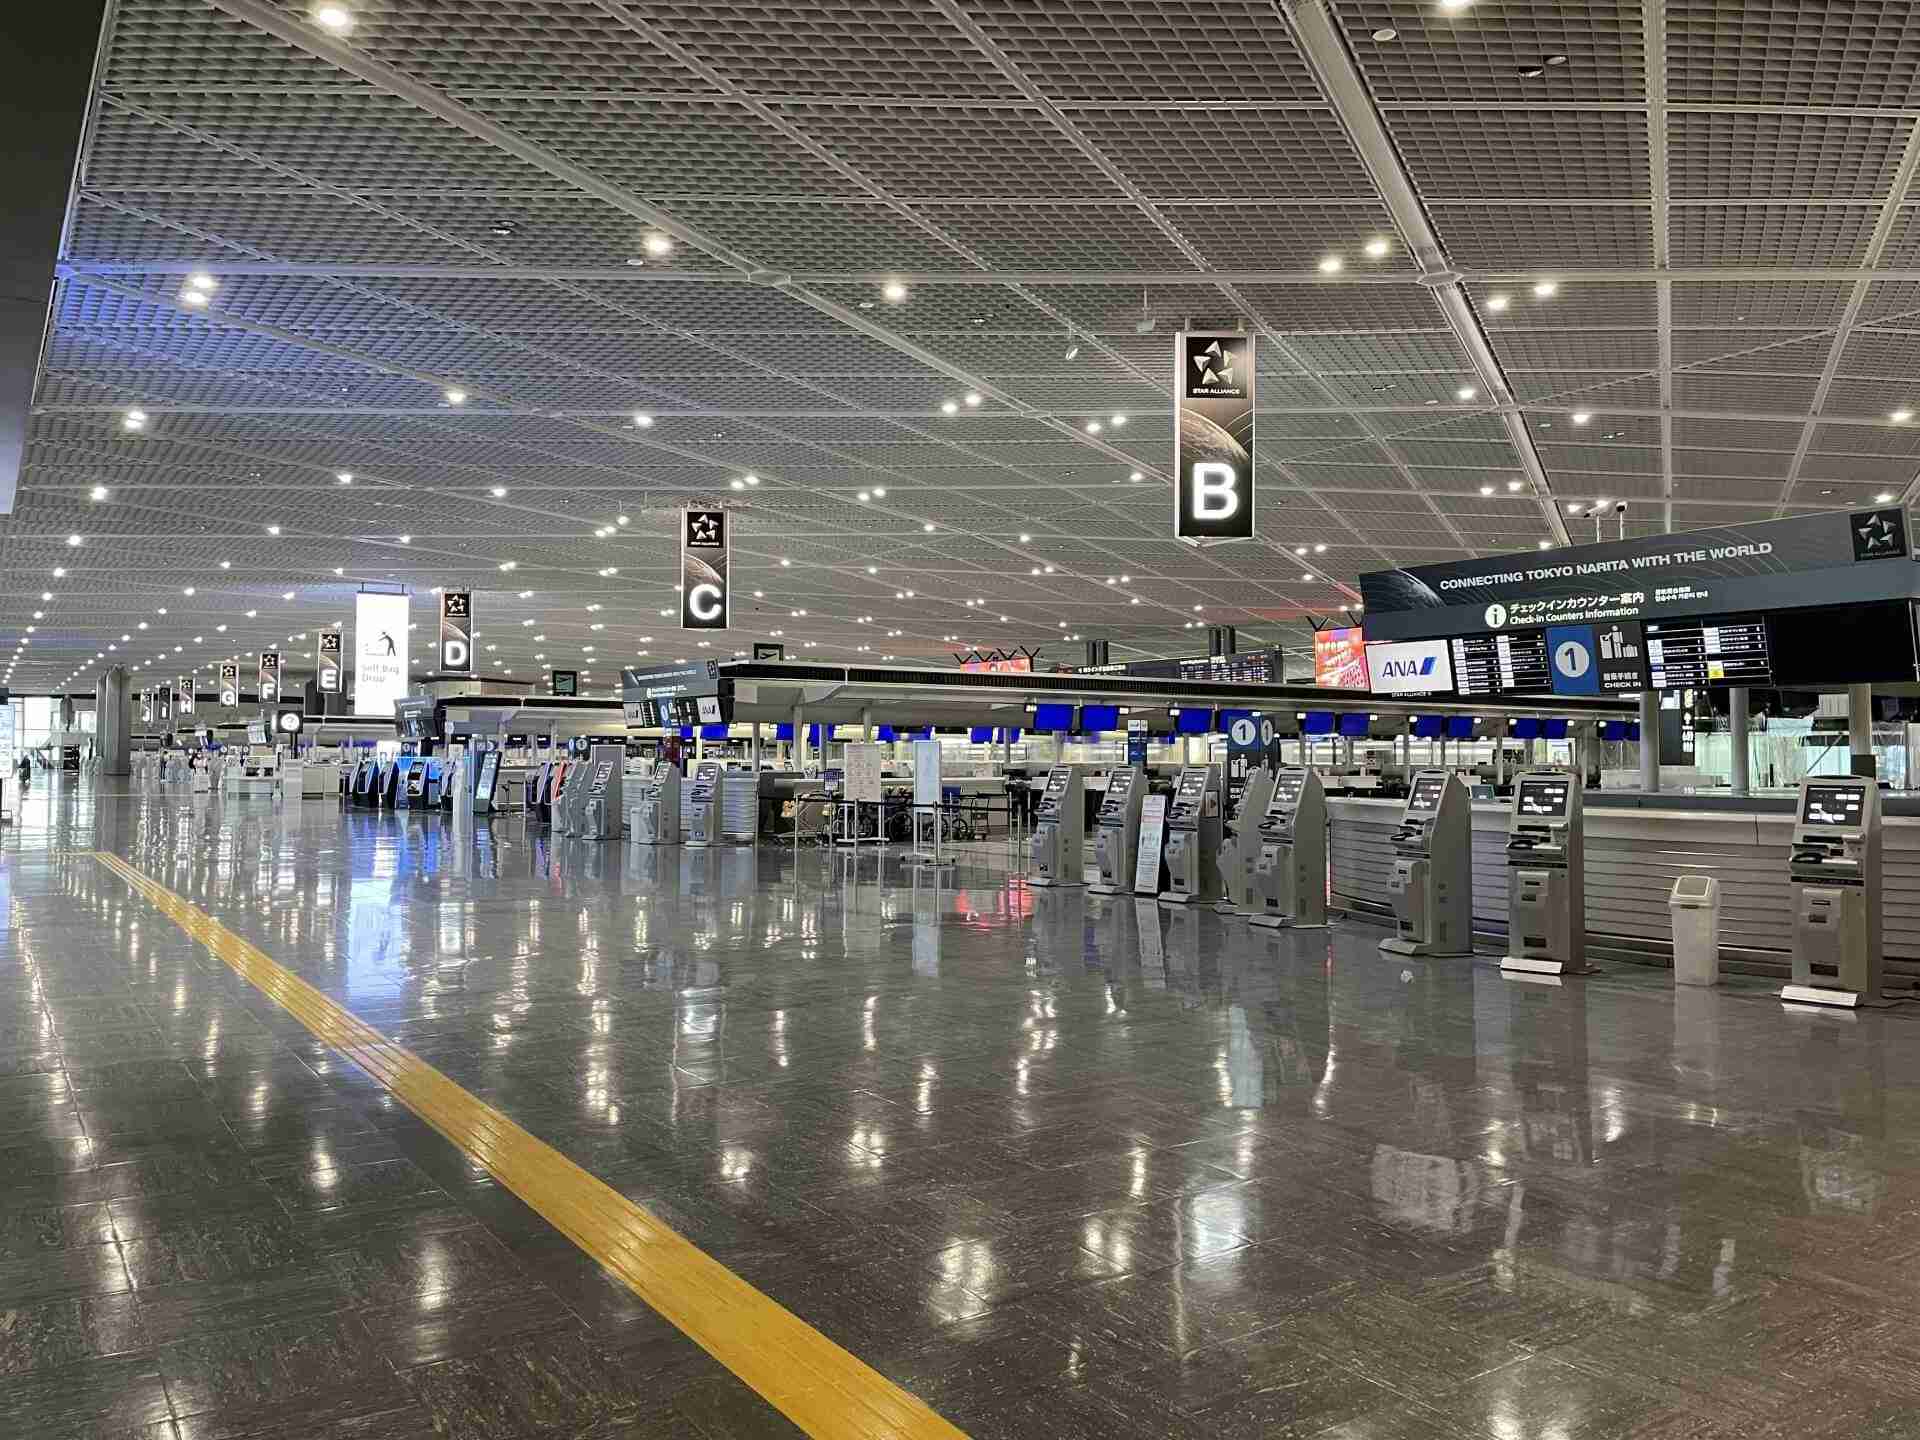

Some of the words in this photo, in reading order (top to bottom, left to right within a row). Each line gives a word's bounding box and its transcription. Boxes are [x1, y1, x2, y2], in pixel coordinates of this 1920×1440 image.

[1192, 462, 1238, 520] B
[1440, 572, 1523, 591] CONNECTING
[1526, 565, 1573, 580] TOKYO
[1576, 559, 1629, 575] NARITA
[1631, 555, 1671, 569] WITH
[1674, 549, 1706, 563] THE
[1710, 542, 1773, 559] WORLD
[690, 583, 722, 620] C
[1509, 591, 1645, 612] チェックインカウンター案内
[1510, 612, 1545, 625] Check-in
[1546, 610, 1584, 622] Counters
[1585, 606, 1639, 620] Information
[444, 640, 467, 666] D
[1564, 647, 1577, 671] 1
[1382, 659, 1418, 678] ANA
[321, 669, 338, 689] E
[221, 690, 236, 706] G
[262, 682, 275, 699] F
[180, 700, 192, 713] H
